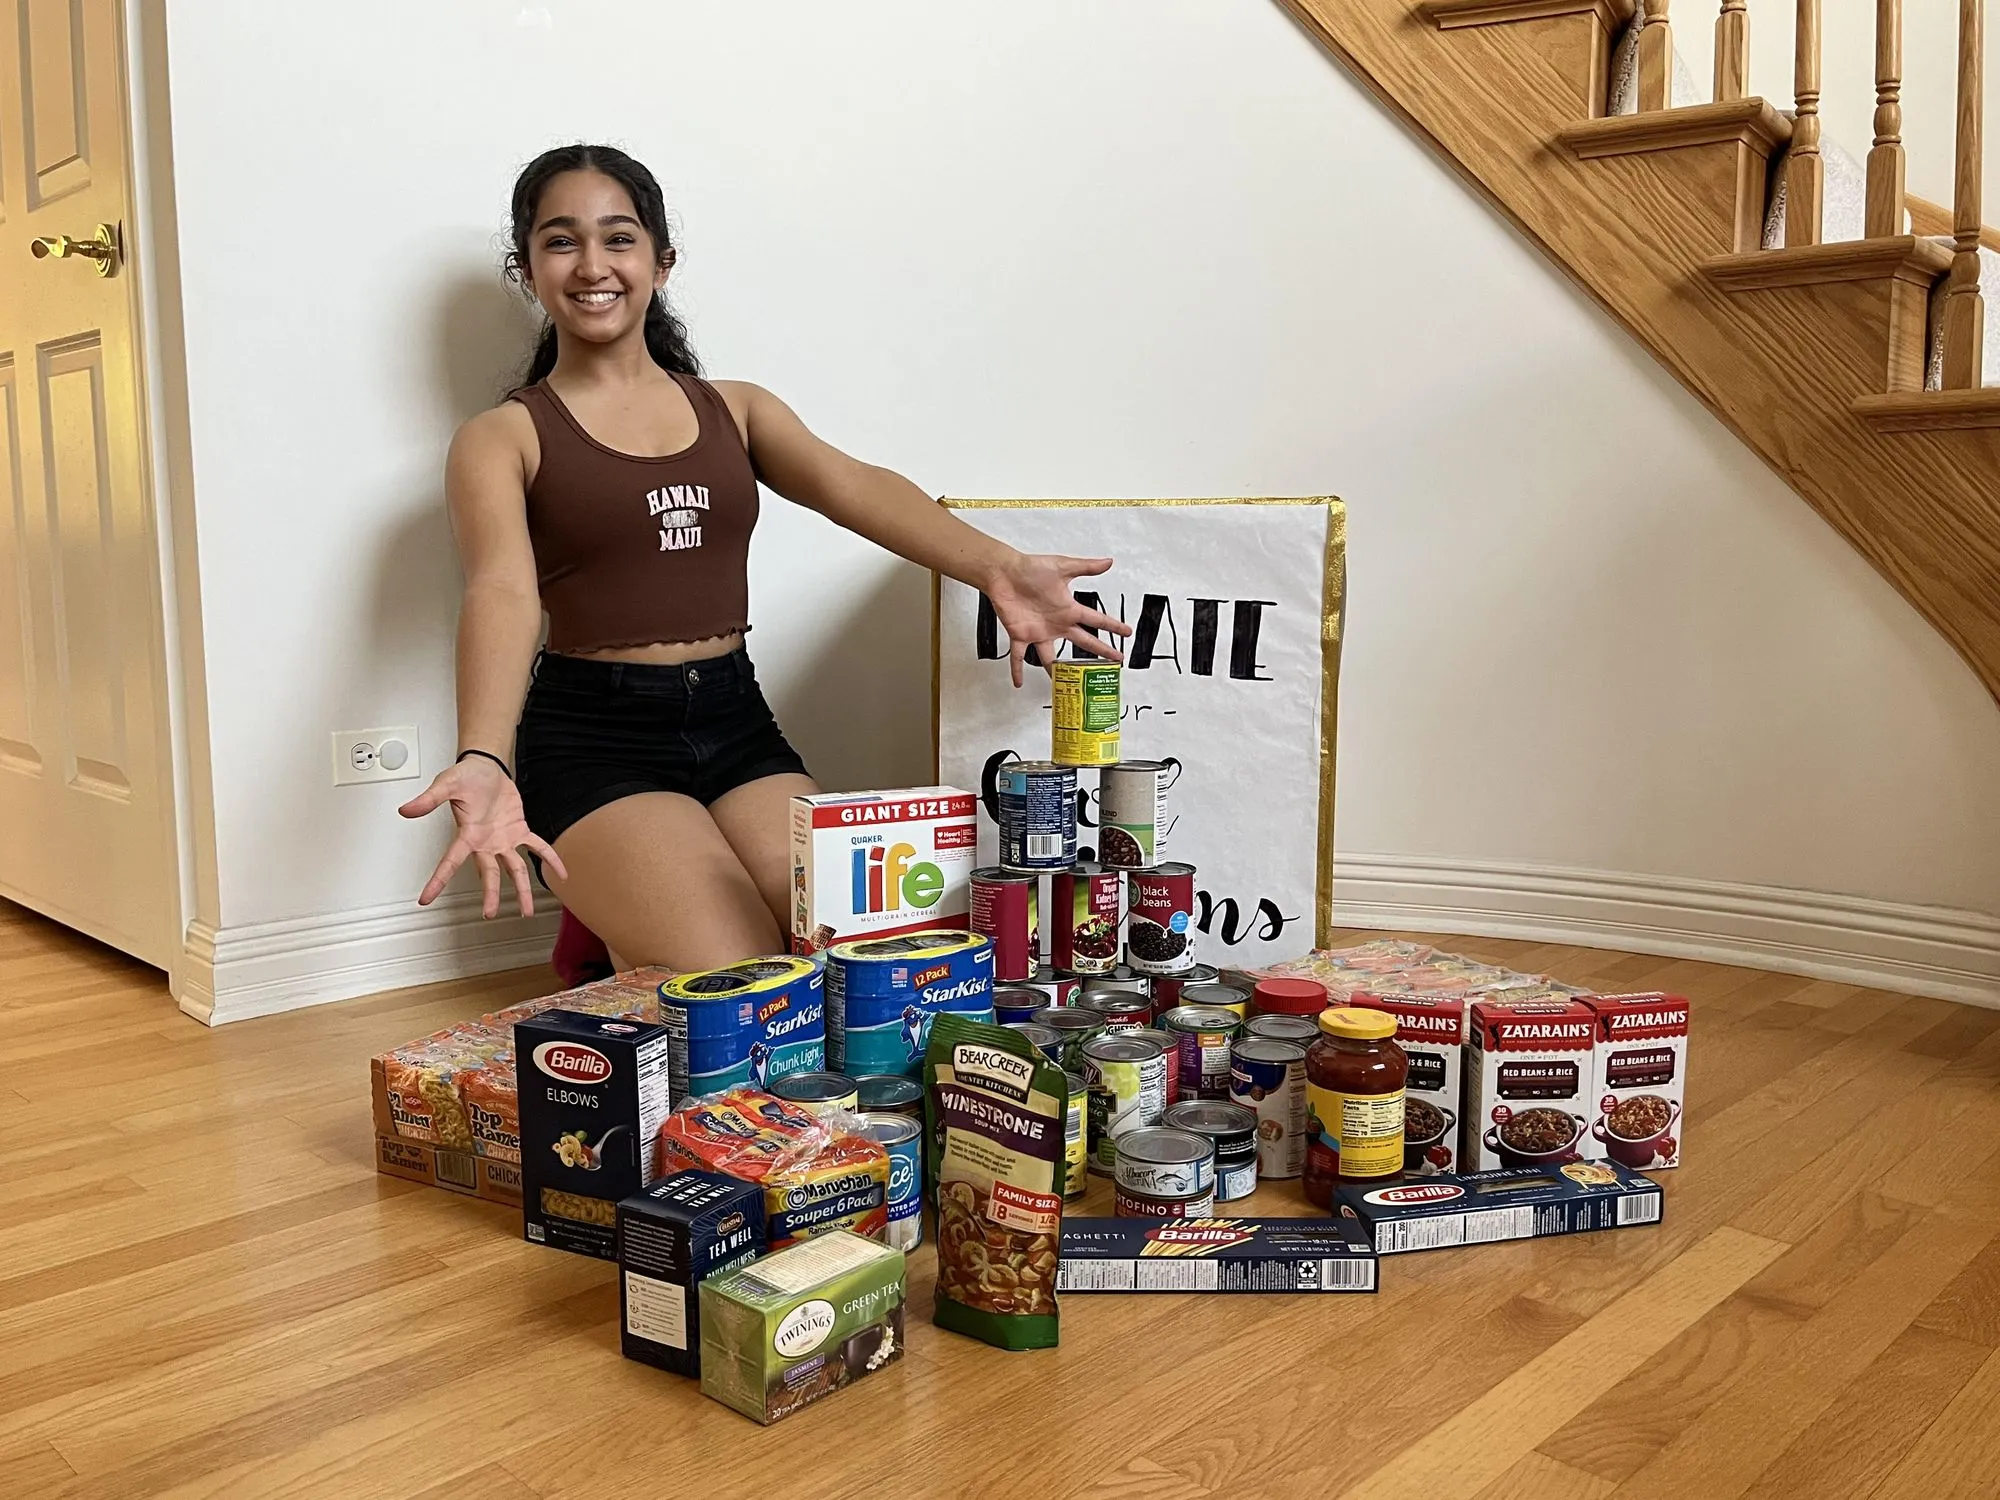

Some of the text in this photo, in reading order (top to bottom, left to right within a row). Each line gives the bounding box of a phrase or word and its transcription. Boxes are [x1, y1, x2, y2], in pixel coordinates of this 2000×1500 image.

[646, 484, 710, 516] HAWAII
[659, 526, 702, 551] MAUI
[977, 590, 1278, 681] DNATE
[841, 804, 902, 823] GIANT
[908, 800, 949, 817] SIZE
[851, 834, 883, 845] QUAKER
[852, 843, 945, 915] life
[1142, 885, 1169, 897] black
[1142, 897, 1172, 908] beans
[861, 909, 937, 923] MULTIGRAIN CEREAL
[915, 966, 948, 987] 12 Pack
[921, 977, 988, 1005] StarKist
[759, 997, 788, 1021] 12 Pack
[1611, 1010, 1686, 1029] ZATARAIN'S
[765, 1003, 822, 1039] StarKist
[1397, 1014, 1457, 1031] ARAIN'S
[1502, 1023, 1590, 1038] ZATARAIN'S
[551, 1050, 605, 1075] Barilla
[770, 1046, 820, 1075] Chunk Light
[959, 1048, 1029, 1080] BEAR CREEK
[1417, 1059, 1441, 1069] & RICE
[1611, 1054, 1671, 1066] RED BEANS & RICE
[1503, 1069, 1519, 1077] RED
[1521, 1069, 1546, 1077] BEANS
[1556, 1068, 1573, 1076] RICE
[547, 1088, 599, 1109] ELBOWS
[986, 1080, 1021, 1098] KITCHENS
[392, 1108, 431, 1128] amen
[469, 1102, 502, 1130] Top
[941, 1092, 1045, 1140] MINESTRONE
[974, 1119, 988, 1129] SOUP
[473, 1121, 520, 1148] Rame
[380, 1136, 404, 1156] Top
[487, 1144, 520, 1162] CHICKE
[382, 1150, 429, 1173] Ramen
[488, 1165, 520, 1186] CHICK
[1456, 1167, 1541, 1182] LINGUINE FINI
[650, 1176, 695, 1197] LIVE WELL
[673, 1182, 711, 1201] BE WELL
[805, 1173, 873, 1198] Maruchan
[1388, 1186, 1456, 1201] Barilla
[688, 1185, 735, 1208] TEA WELL
[997, 1187, 1058, 1209] FAMILY SIZE
[786, 1193, 874, 1228] Souper 6 Pack
[997, 1204, 1007, 1219] 8
[1040, 1214, 1056, 1224] 1/2
[709, 1226, 752, 1260] TEA WELL
[1159, 1230, 1237, 1241] Barilla
[842, 1281, 901, 1314] GREEN TEA
[778, 1315, 832, 1347] TWININGS
[791, 1359, 817, 1377] JASMINE
[772, 1407, 782, 1419] 20
